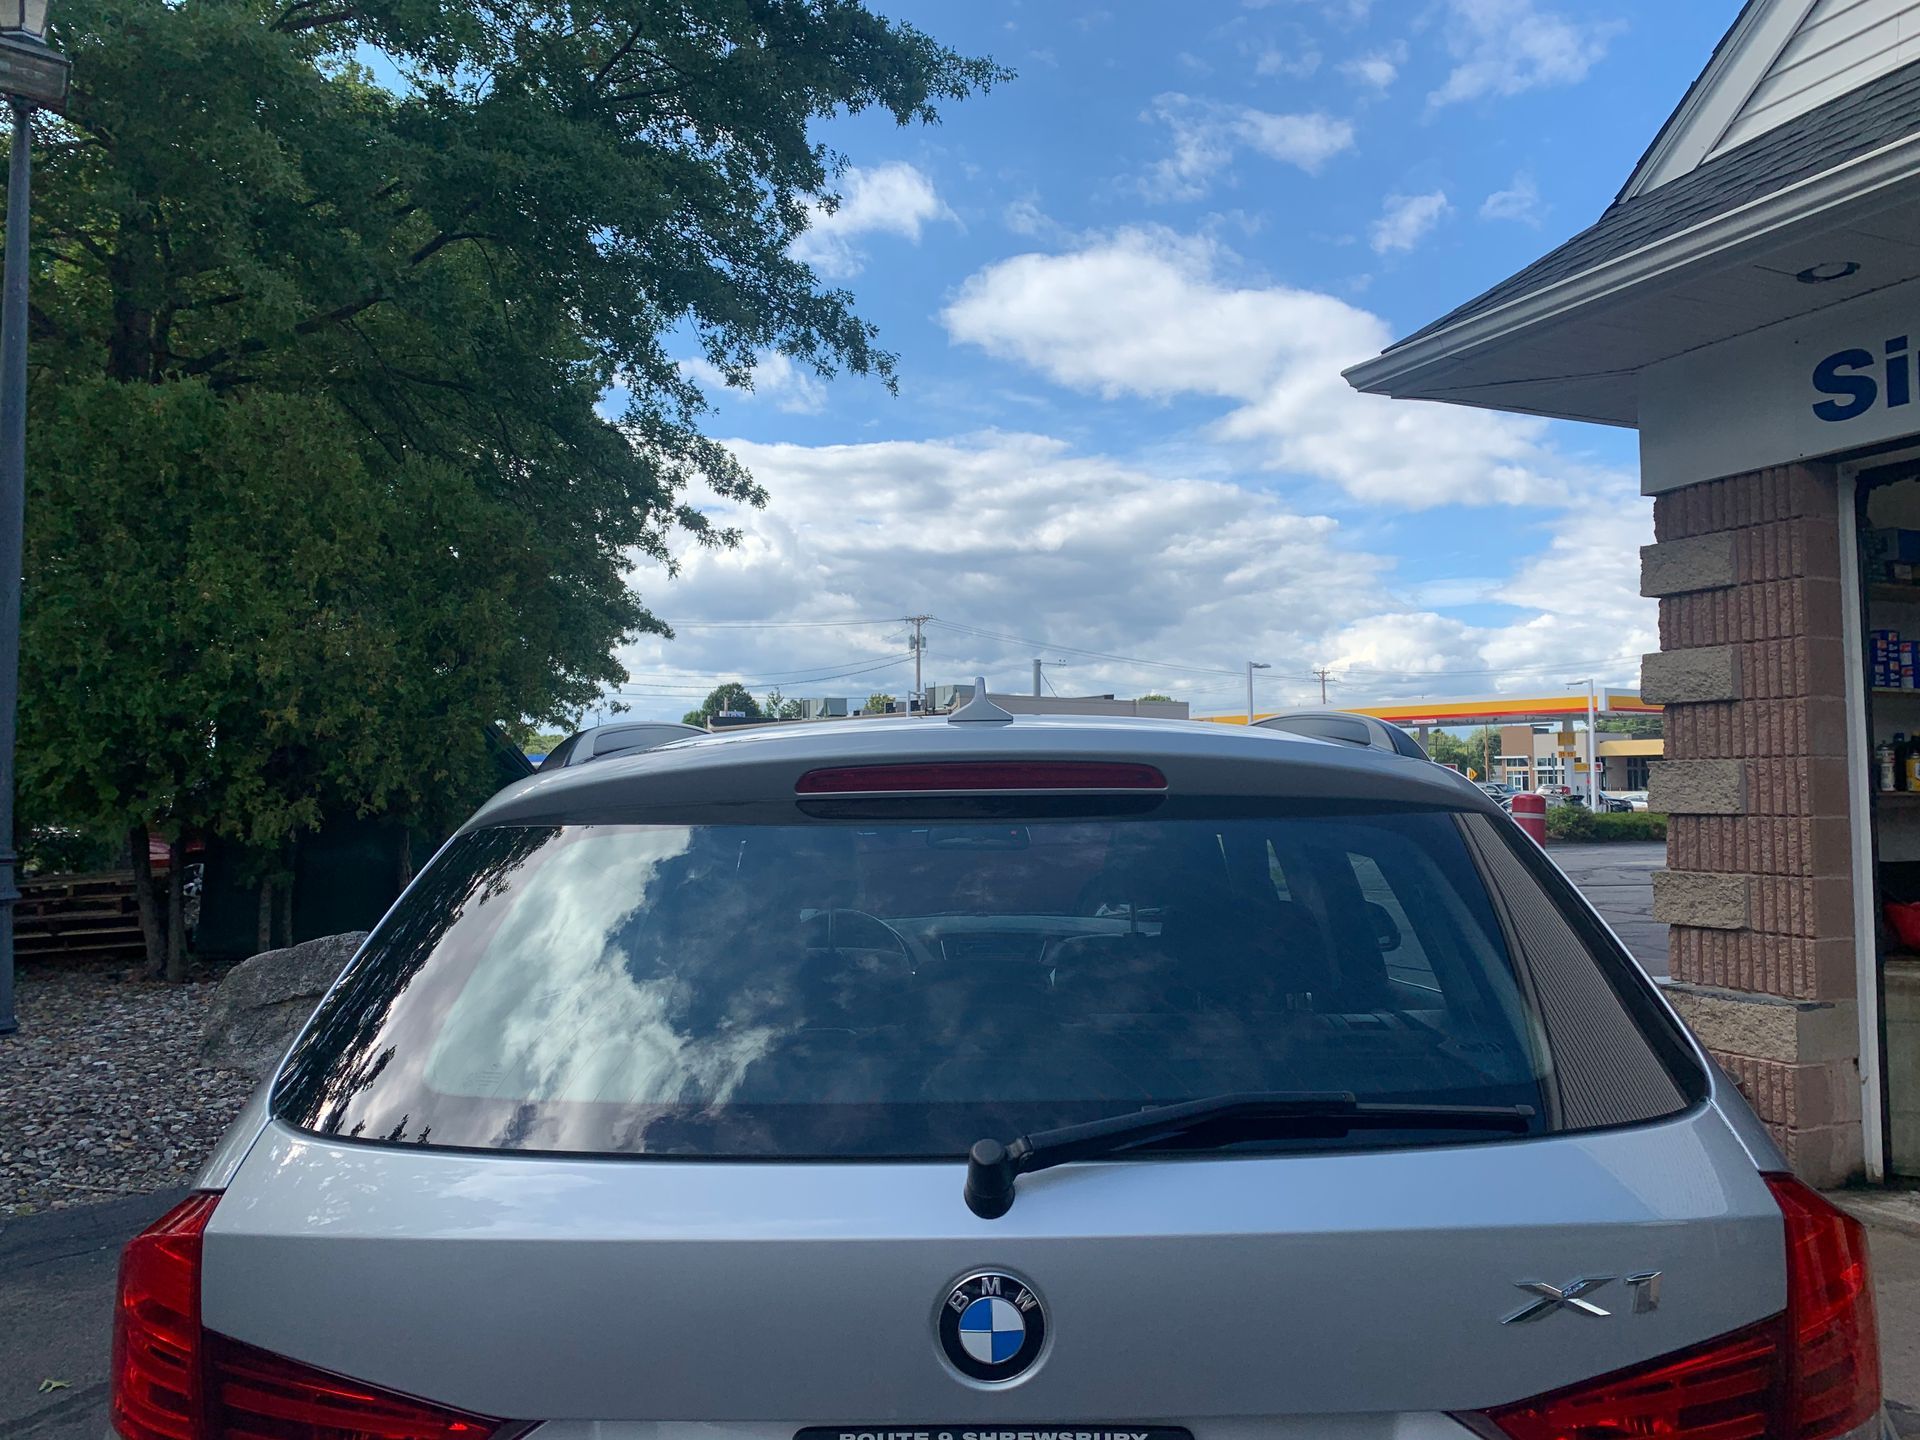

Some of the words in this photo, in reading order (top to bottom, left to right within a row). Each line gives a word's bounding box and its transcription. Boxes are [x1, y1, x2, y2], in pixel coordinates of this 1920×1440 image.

[1812, 333, 1920, 422] Si
[948, 1276, 1038, 1314] BMW
[1501, 1271, 1662, 1324] X1
